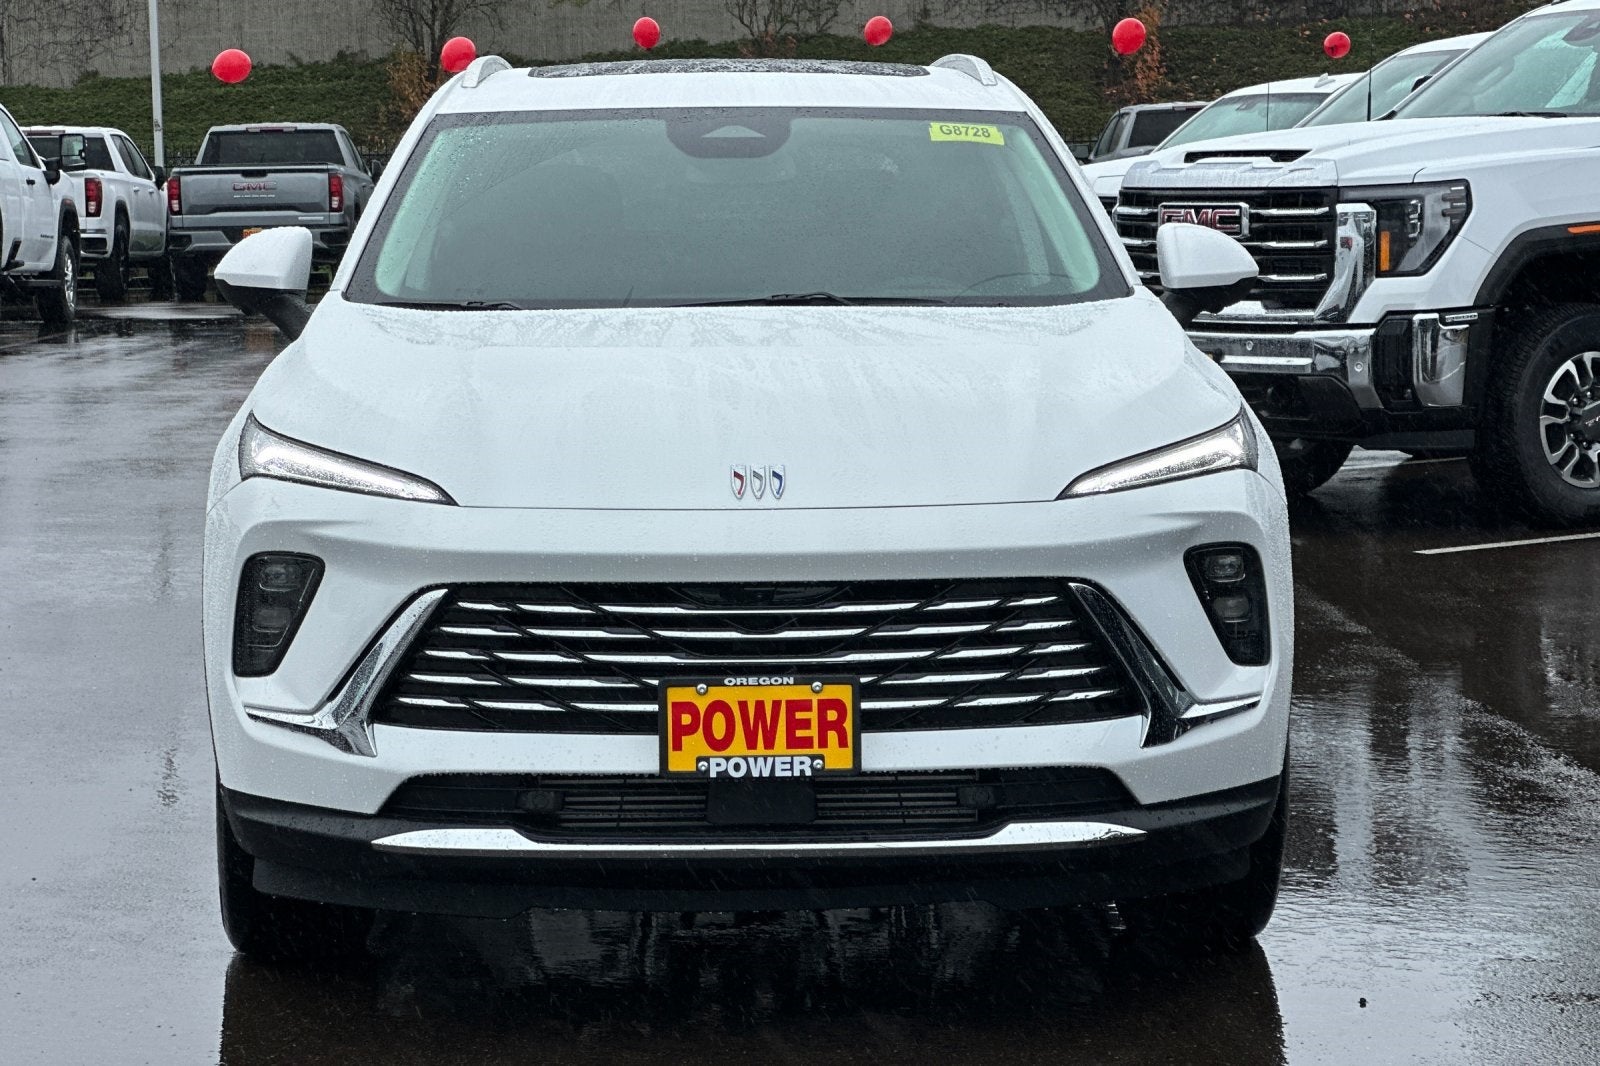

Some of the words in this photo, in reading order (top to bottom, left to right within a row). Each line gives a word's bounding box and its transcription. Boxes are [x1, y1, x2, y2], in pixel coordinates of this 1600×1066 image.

[939, 124, 991, 138] G8728
[232, 182, 277, 191] GMC
[1161, 208, 1240, 232] GMC
[723, 676, 795, 686] OREGON
[671, 698, 849, 752] POWER
[709, 756, 813, 778] POWER
